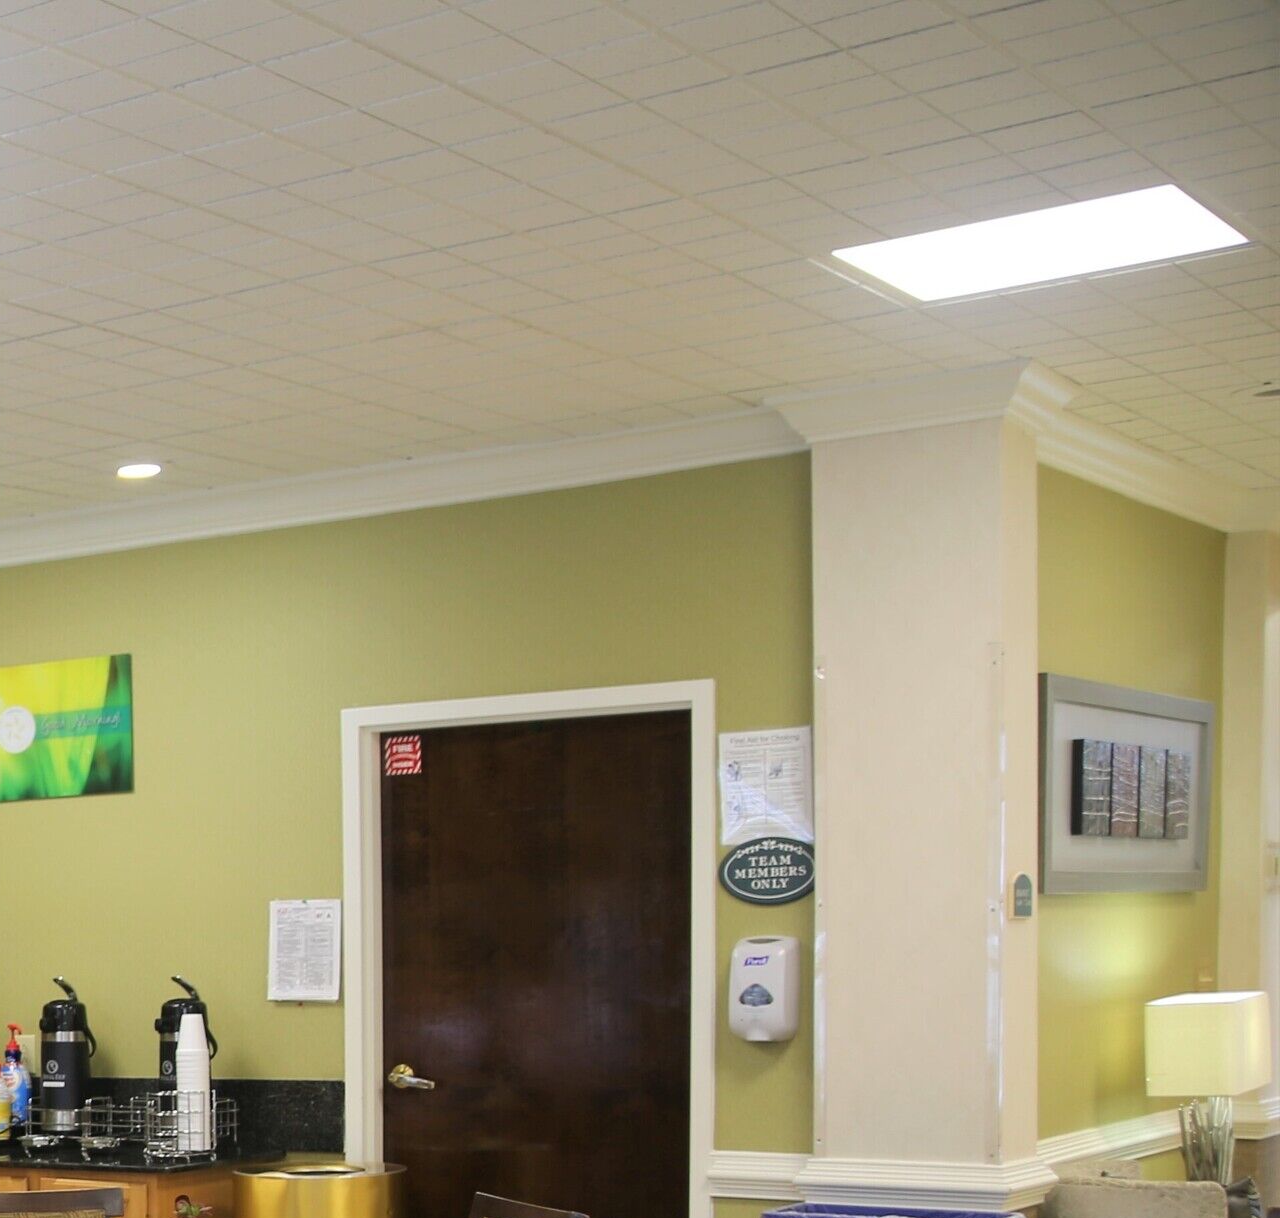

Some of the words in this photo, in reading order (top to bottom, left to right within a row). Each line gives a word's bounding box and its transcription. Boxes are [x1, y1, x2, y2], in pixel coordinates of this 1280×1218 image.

[392, 743, 414, 753] FIRE
[748, 854, 792, 867] TEAM
[734, 865, 807, 879] MEMBERS
[750, 877, 790, 890] ONLY
